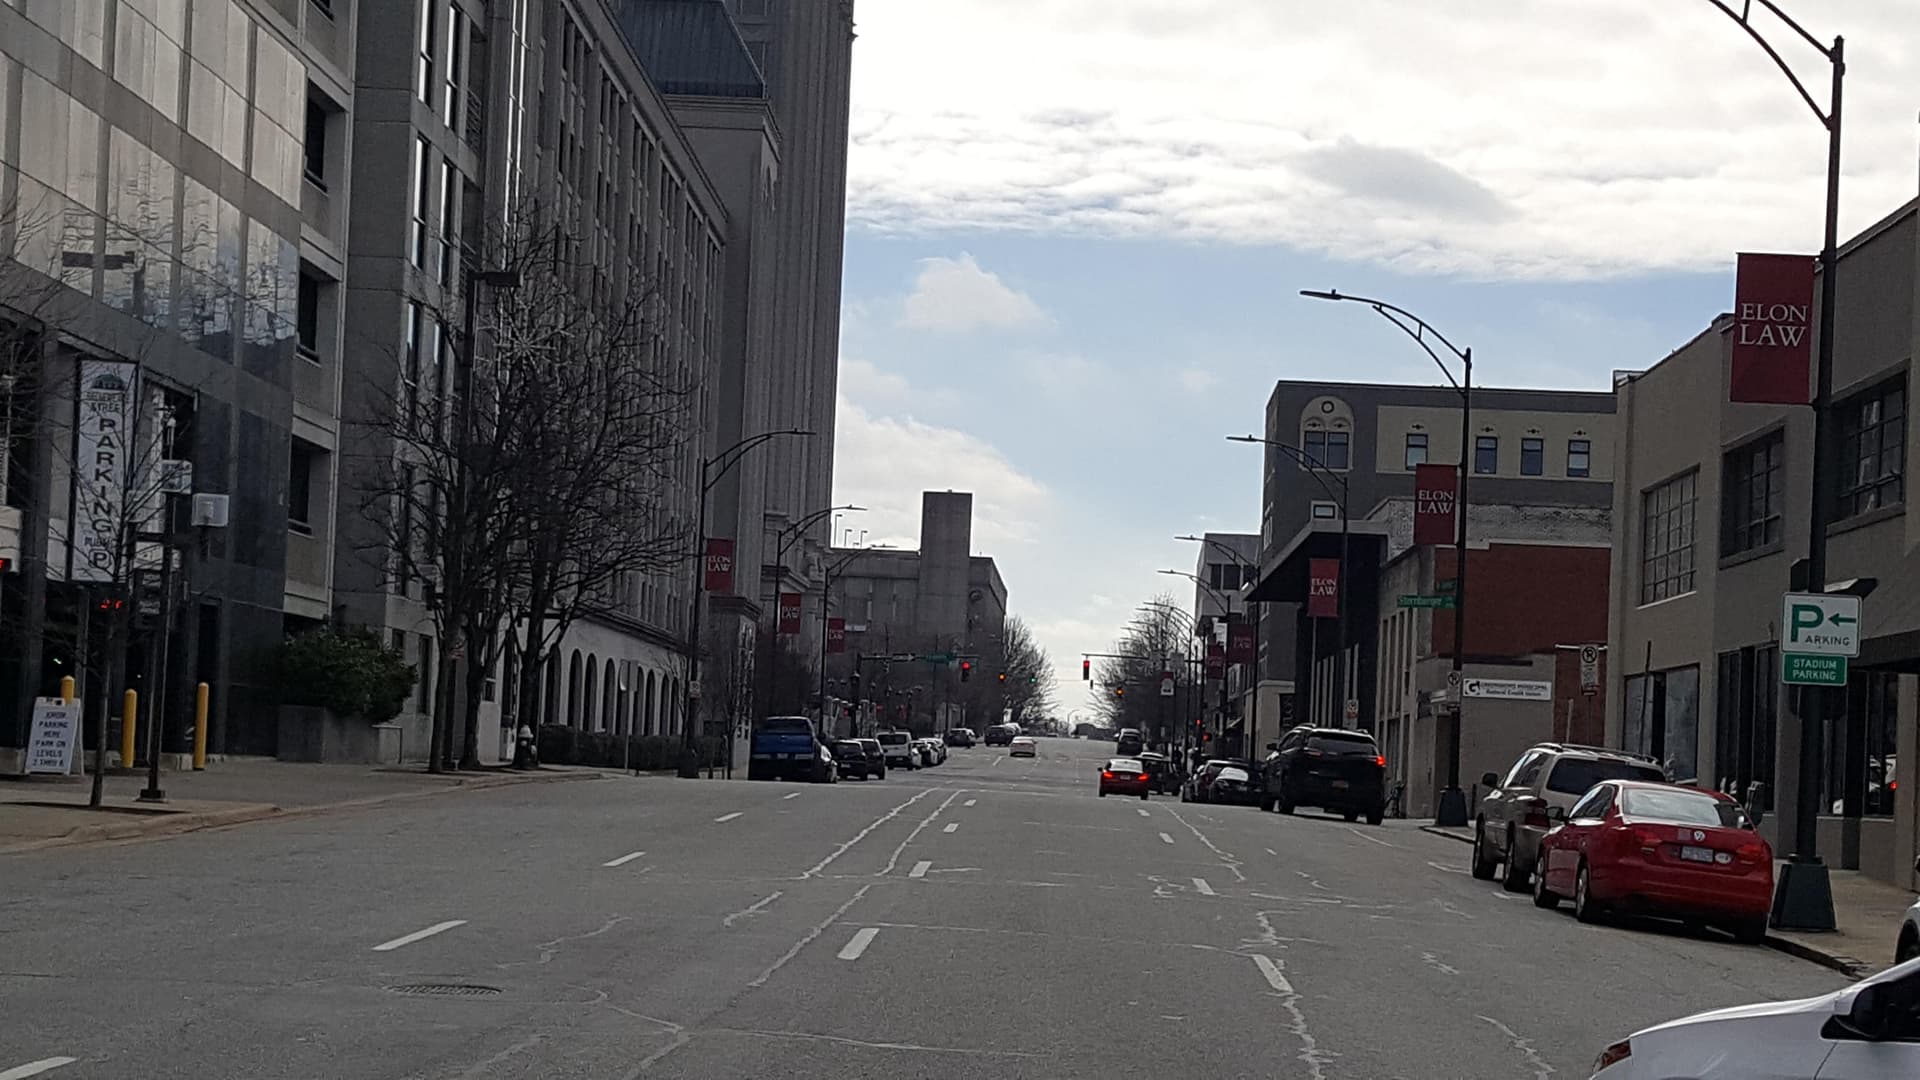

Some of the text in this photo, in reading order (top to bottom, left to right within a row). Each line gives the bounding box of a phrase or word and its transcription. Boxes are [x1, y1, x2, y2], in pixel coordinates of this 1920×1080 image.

[1741, 303, 1809, 322] ELON
[1739, 324, 1807, 347] LAW
[92, 418, 116, 532] PARKING
[1418, 489, 1454, 500] ELON
[1417, 501, 1453, 514] LAW
[707, 562, 732, 572] LAW
[1311, 578, 1337, 586] ELON
[1310, 586, 1337, 596] LAW
[1793, 658, 1837, 669] STADIUM
[1792, 669, 1837, 681] PARKING
